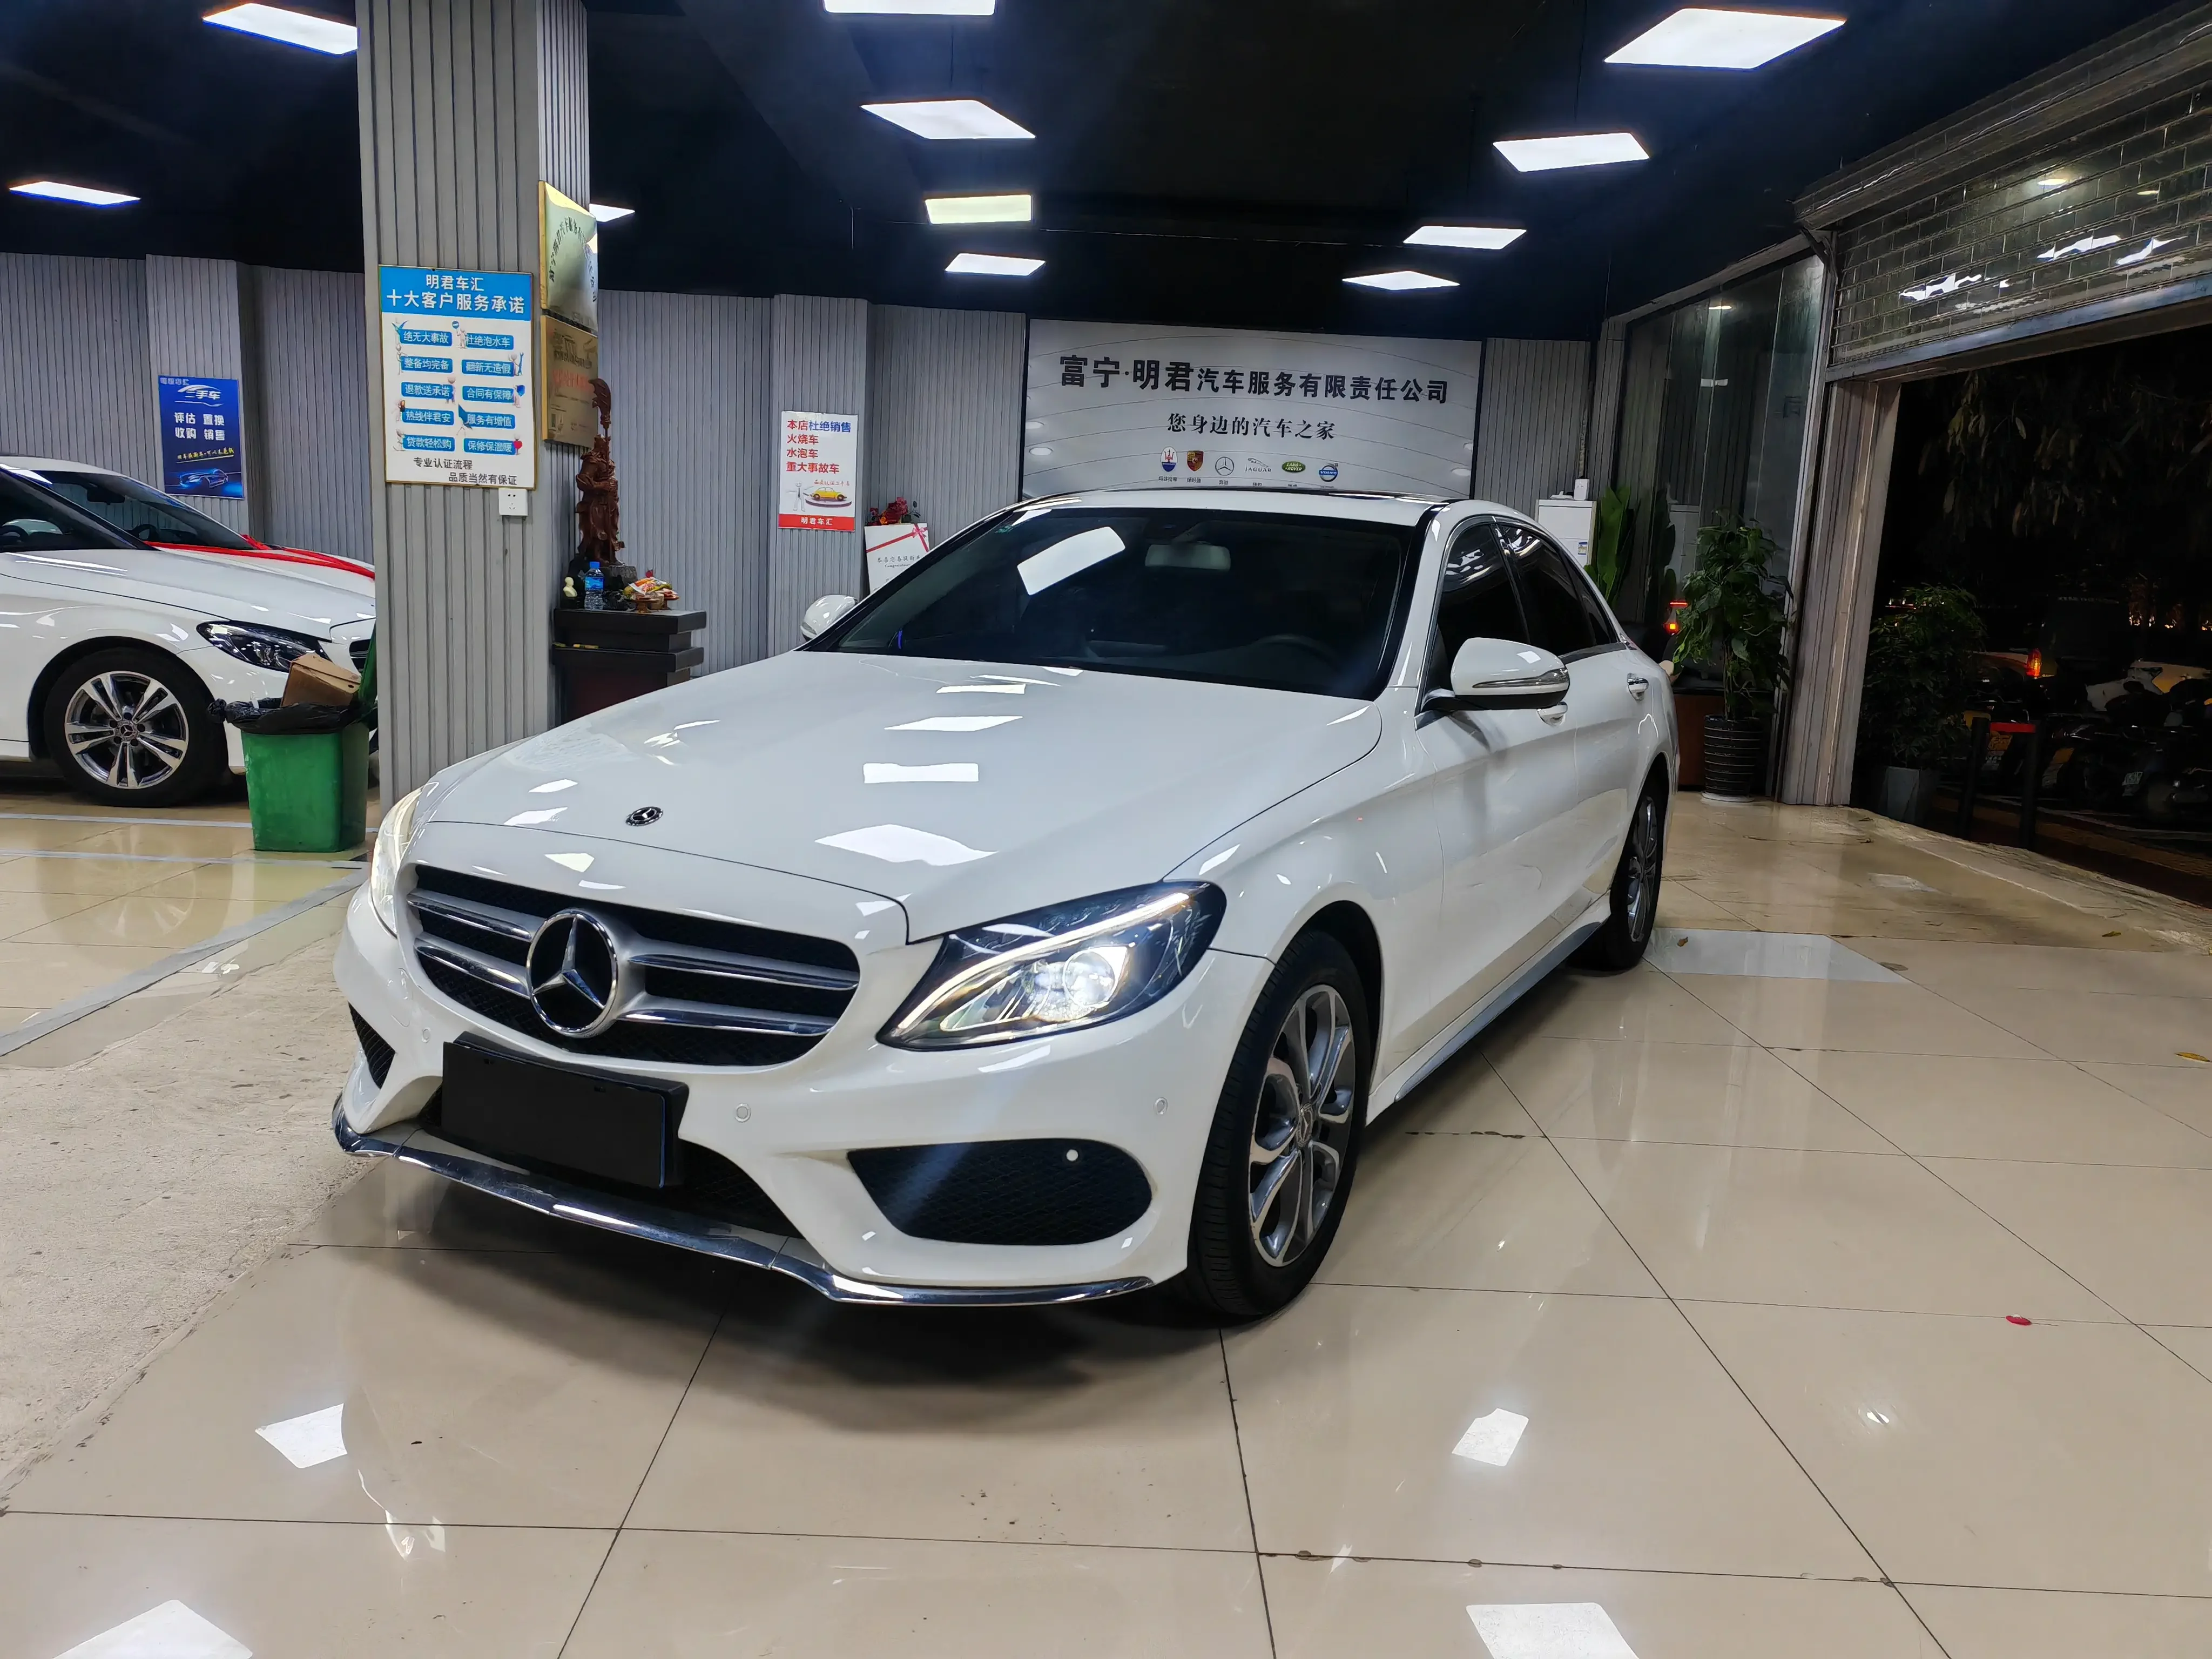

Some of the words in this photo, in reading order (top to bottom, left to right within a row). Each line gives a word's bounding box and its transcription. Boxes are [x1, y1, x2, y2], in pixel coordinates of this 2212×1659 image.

[426, 274, 484, 292] 明君车汇
[387, 289, 525, 314] 十大客户服务承诺
[403, 331, 449, 345] 绝无大事故
[466, 334, 510, 348] 杜绝泡水车
[404, 357, 449, 371] 整备均完备
[185, 390, 222, 400] 二手车
[467, 387, 512, 402] 合同有保障
[174, 412, 196, 424] 评估
[203, 414, 225, 426] 置换
[467, 413, 512, 428] 服务有增值
[787, 419, 852, 433] 本店杜绝销售
[1167, 413, 1335, 440] 您身边的汽车之家
[175, 427, 197, 439] 收购
[204, 429, 225, 441] 销售
[787, 434, 819, 445] 火烧车
[786, 448, 819, 459] 水泡车
[413, 456, 473, 470] 专业认证流程
[786, 462, 840, 474] 重大事故车
[449, 472, 517, 485] 品质当然有保证
[801, 516, 833, 526] 明君车汇
